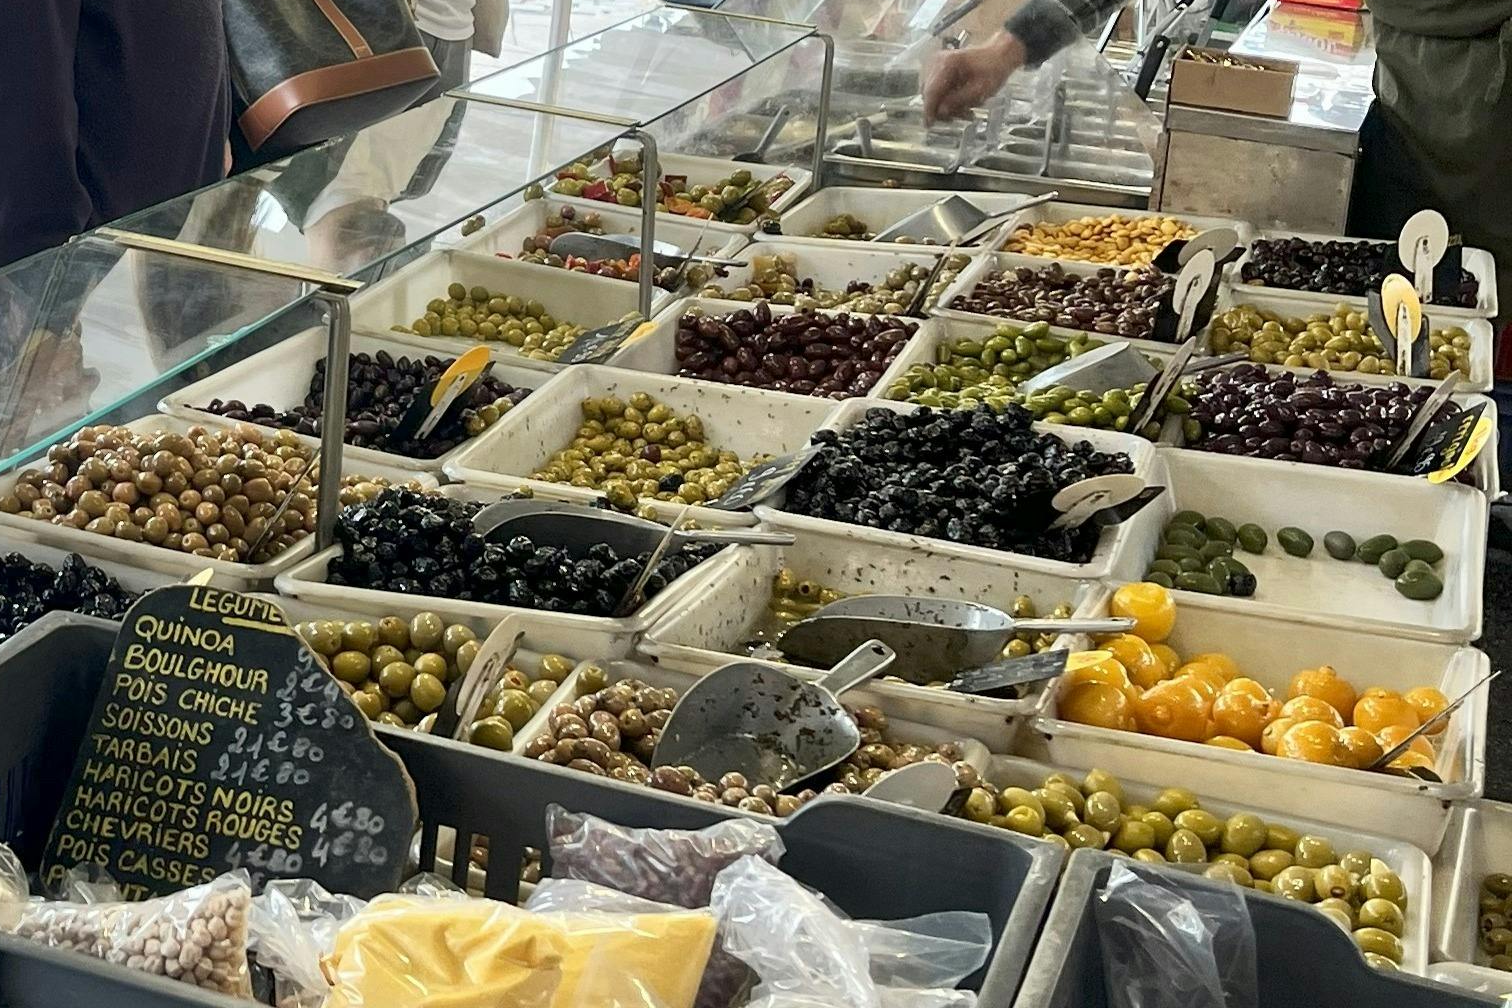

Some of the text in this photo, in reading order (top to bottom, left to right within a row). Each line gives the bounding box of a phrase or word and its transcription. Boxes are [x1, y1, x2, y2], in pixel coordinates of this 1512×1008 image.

[135, 614, 235, 656] QUINOA
[124, 643, 269, 695] BOULGHOUR
[101, 702, 215, 746] SOISSONS
[112, 672, 169, 706] POIS
[178, 687, 263, 726] CHICHE
[91, 733, 199, 775] TARBAIS
[82, 757, 208, 806] HARICOTS
[211, 785, 294, 824] NOIRS
[66, 809, 210, 860] CHEVRIERS
[74, 784, 200, 830] HARICOTS
[205, 809, 303, 850] ROUGES
[56, 834, 112, 866] POIS
[117, 849, 216, 887] CASSES
